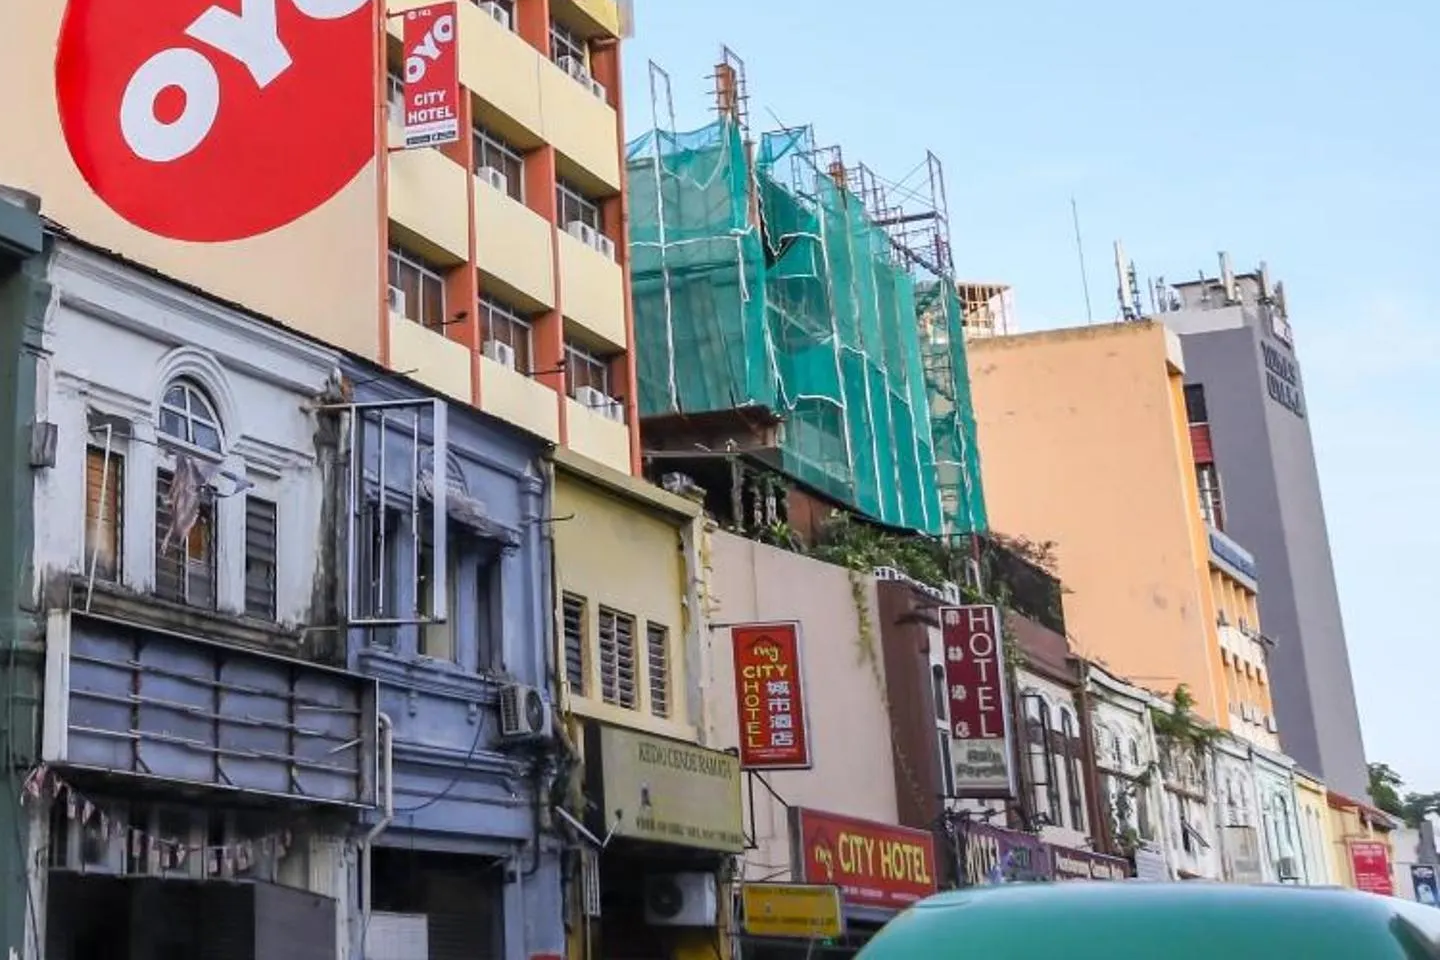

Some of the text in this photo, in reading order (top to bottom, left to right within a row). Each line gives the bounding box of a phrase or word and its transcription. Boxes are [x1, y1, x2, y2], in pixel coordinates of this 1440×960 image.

[405, 14, 453, 84] OYO
[408, 106, 454, 124] HOTEL
[414, 90, 447, 106] CITY
[742, 664, 788, 679] CITY
[968, 608, 998, 738] HOTEL
[744, 681, 764, 747] HOTEL
[766, 680, 794, 746] 城市酒店
[838, 831, 874, 877] CITY
[879, 840, 932, 885] HOTEL
